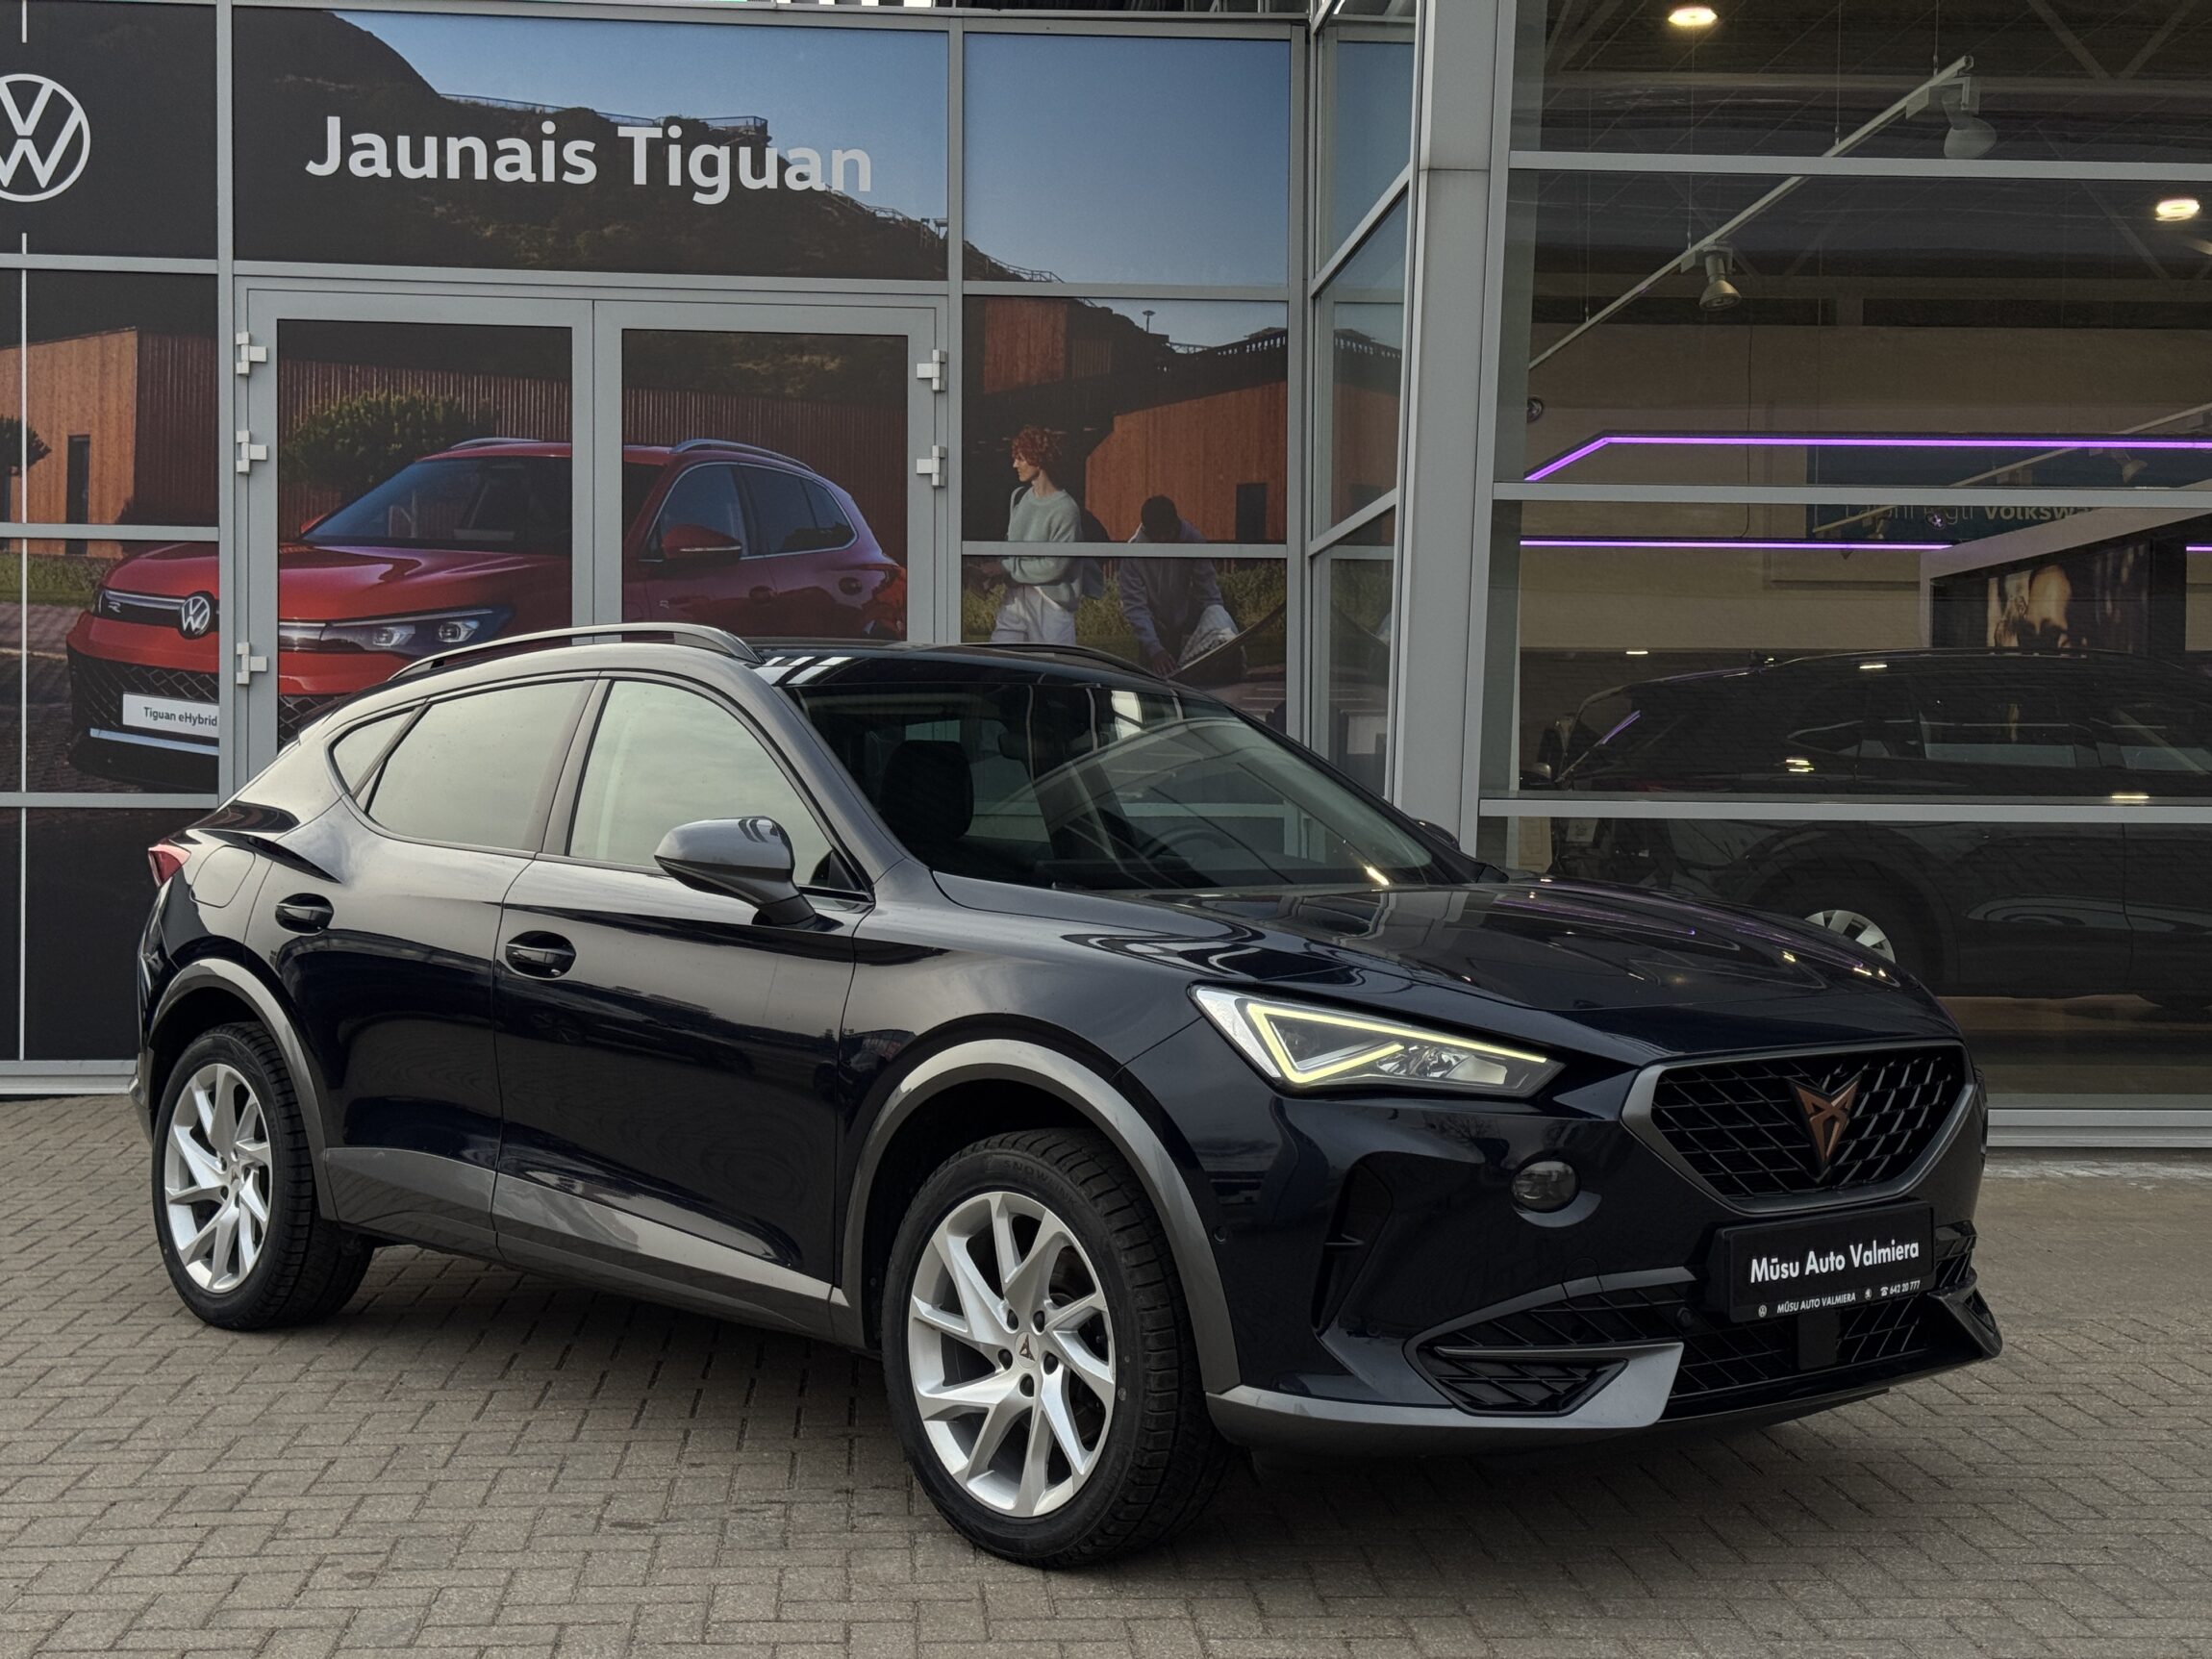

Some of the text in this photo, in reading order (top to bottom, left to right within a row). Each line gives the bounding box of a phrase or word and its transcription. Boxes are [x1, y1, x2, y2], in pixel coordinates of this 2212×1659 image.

[305, 115, 872, 204] Jaunais Tiguan
[143, 706, 217, 726] Tiguan eHybrid
[1750, 1239, 1920, 1284] Mūsu Auto Valmiera
[1776, 1279, 1921, 1314] MŪSU AUTO VALMIERA 642 20 777
